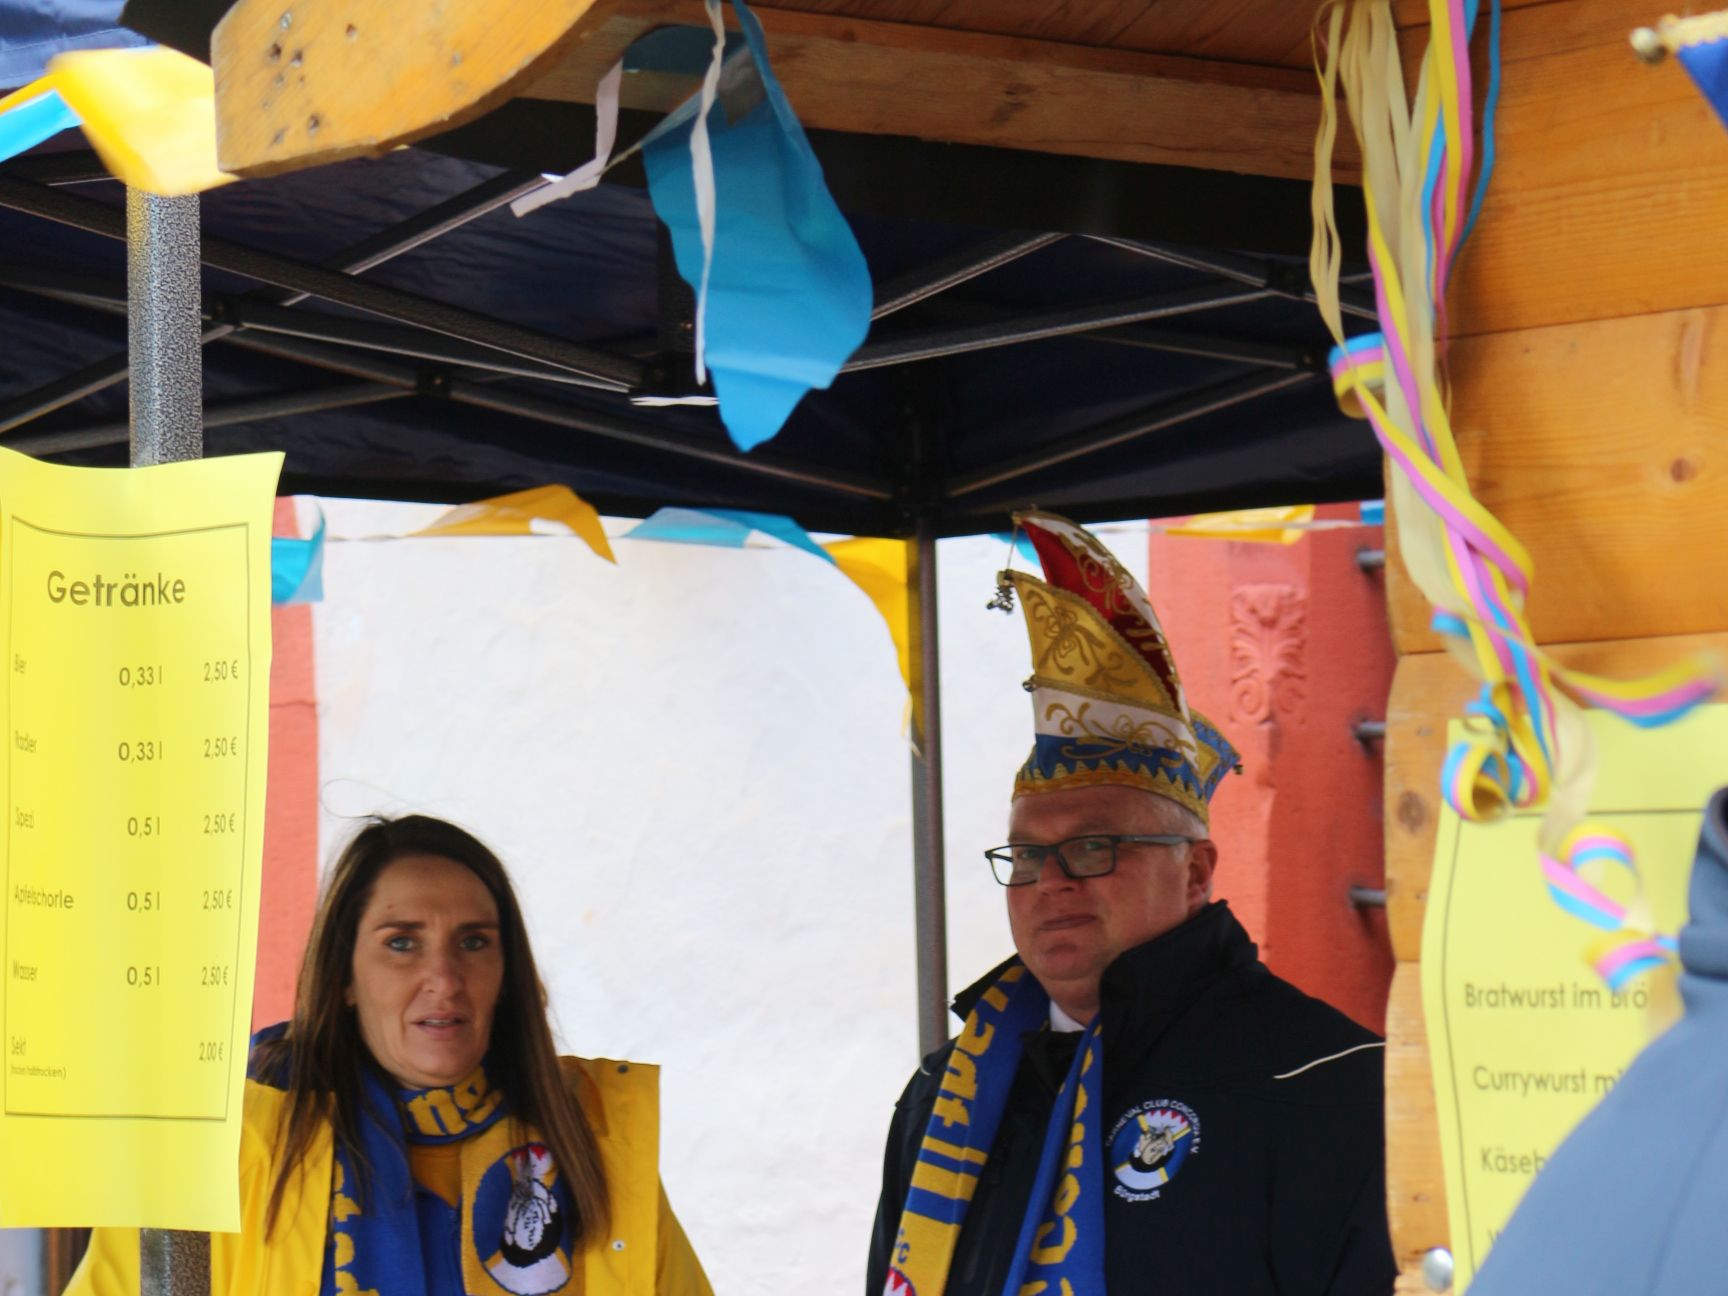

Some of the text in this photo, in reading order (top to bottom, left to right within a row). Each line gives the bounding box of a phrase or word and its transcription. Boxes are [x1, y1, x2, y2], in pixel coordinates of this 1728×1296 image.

[47, 570, 186, 607] Getränke
[119, 666, 154, 689] 0,33
[203, 661, 228, 683] 2,50
[230, 659, 239, 680] €
[118, 741, 154, 763] 0,33
[203, 737, 228, 759] 2,50
[230, 736, 238, 756] €
[127, 816, 152, 839] 0,5
[203, 813, 227, 836] 2,50
[228, 812, 236, 833] €
[14, 884, 74, 909] Apfelschorle
[127, 891, 152, 913] 0,5
[202, 889, 225, 911] 2,50
[226, 889, 233, 909] €
[126, 966, 152, 988] 0,5
[201, 966, 221, 987] 2,50
[223, 965, 229, 986] €
[1464, 983, 1565, 1009] Bratwurst
[1572, 983, 1601, 1008] im
[199, 1041, 217, 1062] 2,00
[218, 1041, 224, 1062] €
[1473, 1065, 1587, 1097] Currywurst
[1143, 1099, 1169, 1110] CLUB
